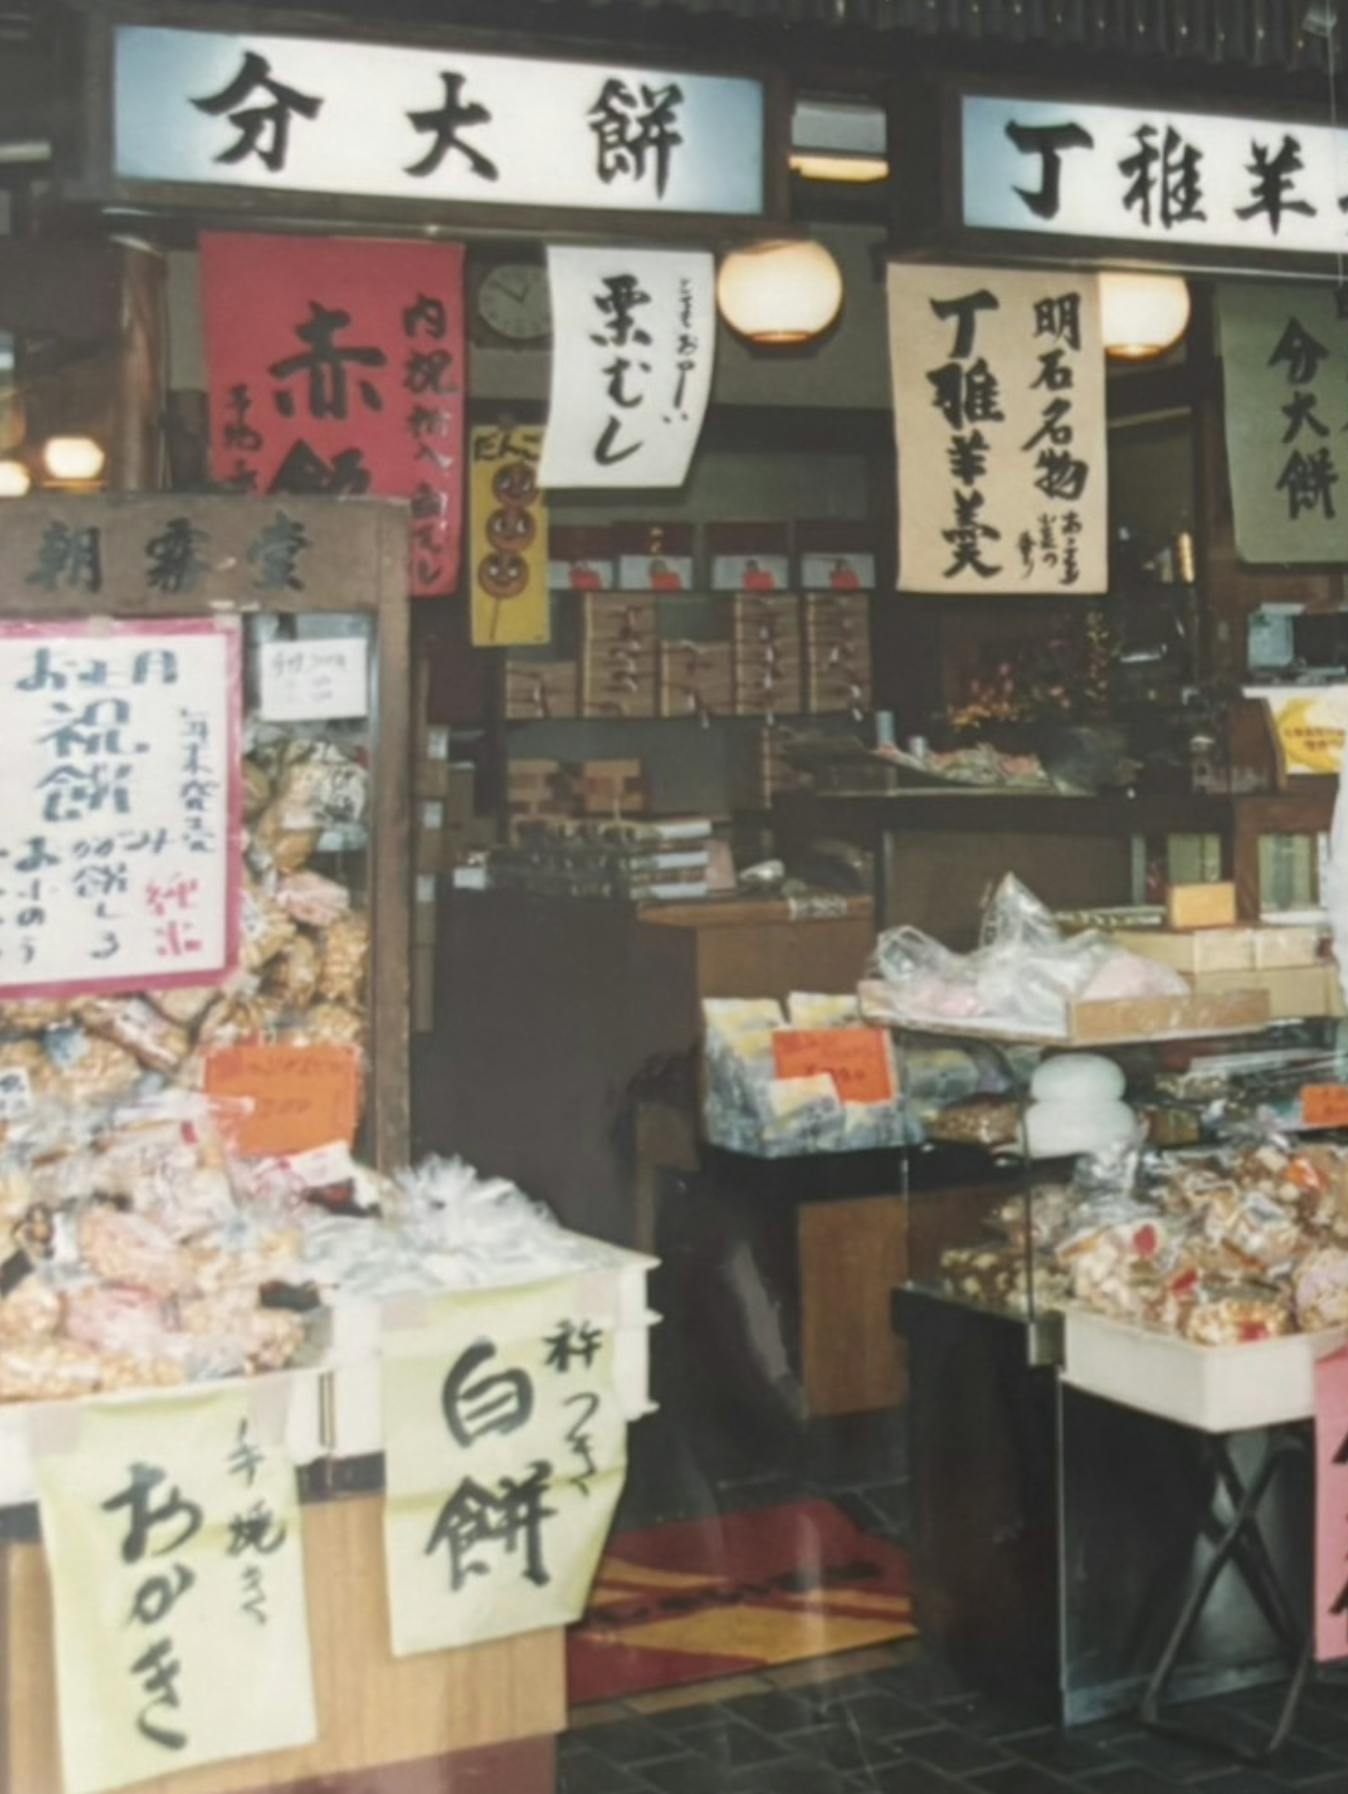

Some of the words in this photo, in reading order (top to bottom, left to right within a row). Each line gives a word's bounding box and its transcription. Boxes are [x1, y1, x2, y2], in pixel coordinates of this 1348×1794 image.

[190, 50, 686, 200] 分大餅
[1021, 291, 1089, 501] 明石名物
[1266, 315, 1340, 520] 分大餅
[224, 1417, 287, 1627] 手焼き
[423, 1338, 559, 1593] 白餅
[100, 1460, 205, 1750] おかき
